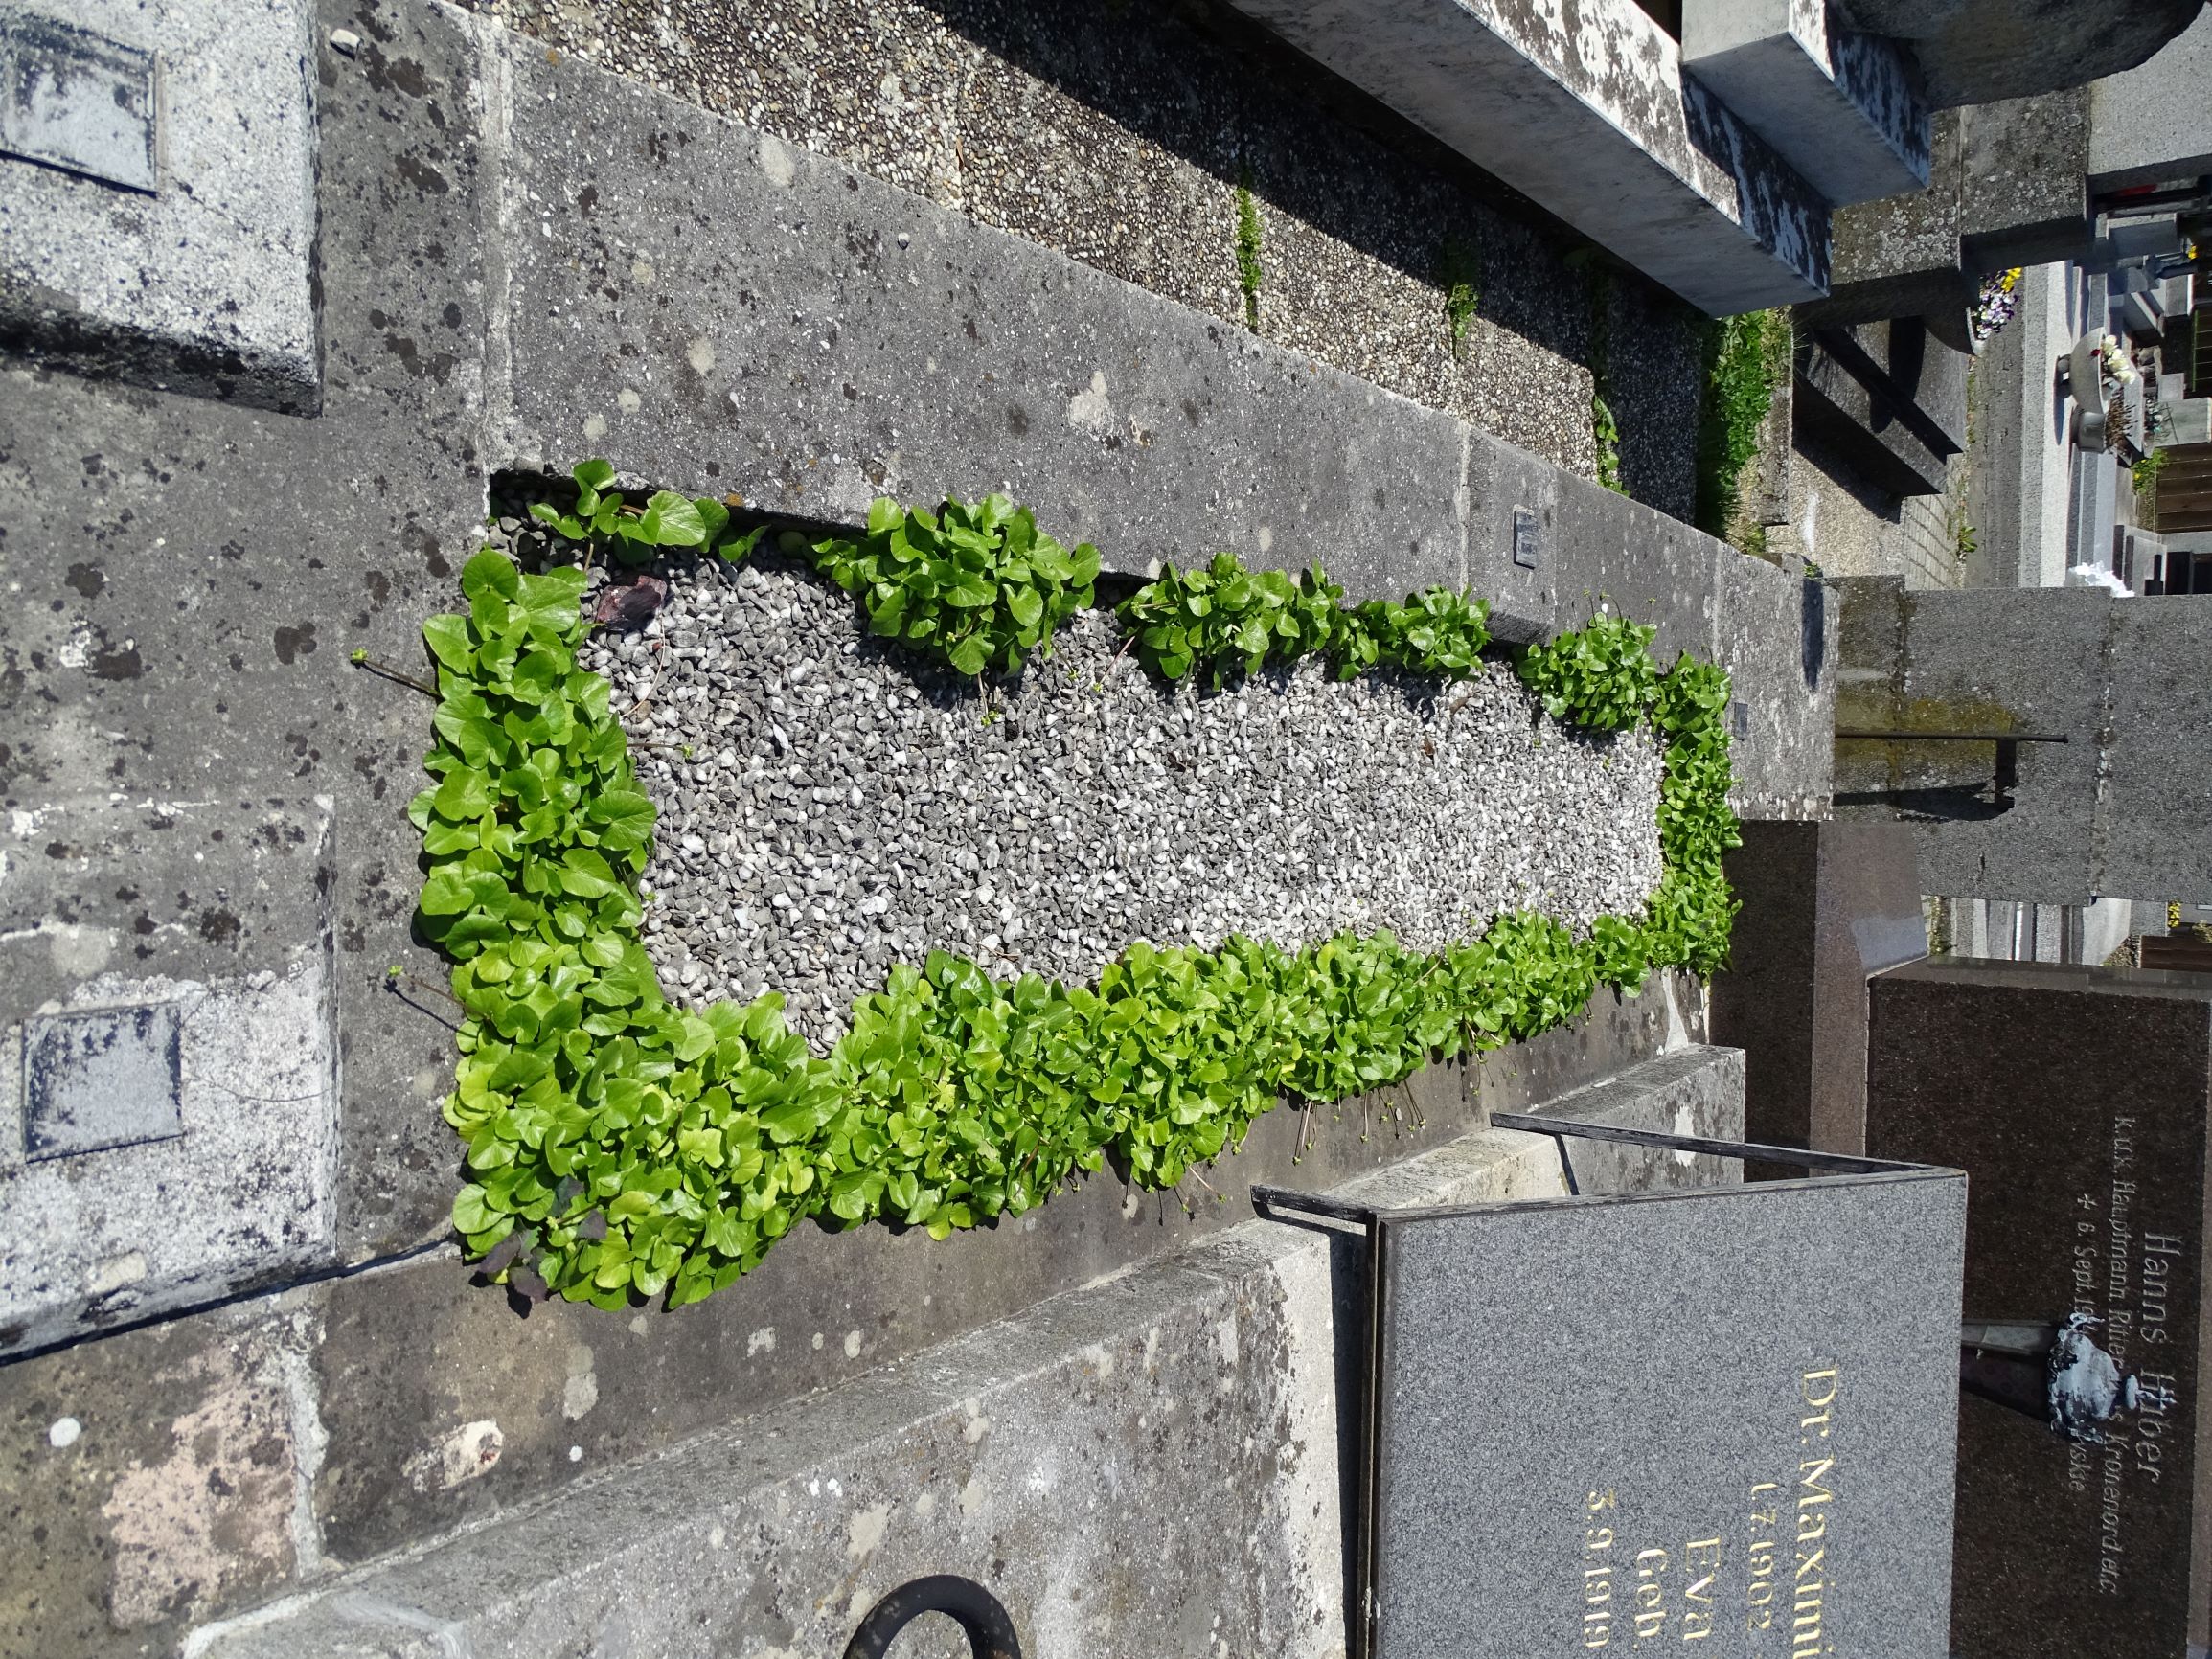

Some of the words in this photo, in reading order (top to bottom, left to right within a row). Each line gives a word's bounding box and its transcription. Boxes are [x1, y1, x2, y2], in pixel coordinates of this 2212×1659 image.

[2108, 1308, 2132, 1369] Ritter
[2140, 1232, 2181, 1344] Hanns
[1800, 1367, 1837, 1444] Dr.
[1584, 1488, 1615, 1648] 3.9.1919
[1632, 1548, 1668, 1649] Geb.
[1683, 1536, 1721, 1641] Eva
[1747, 1483, 1778, 1631] 1.7.1902
